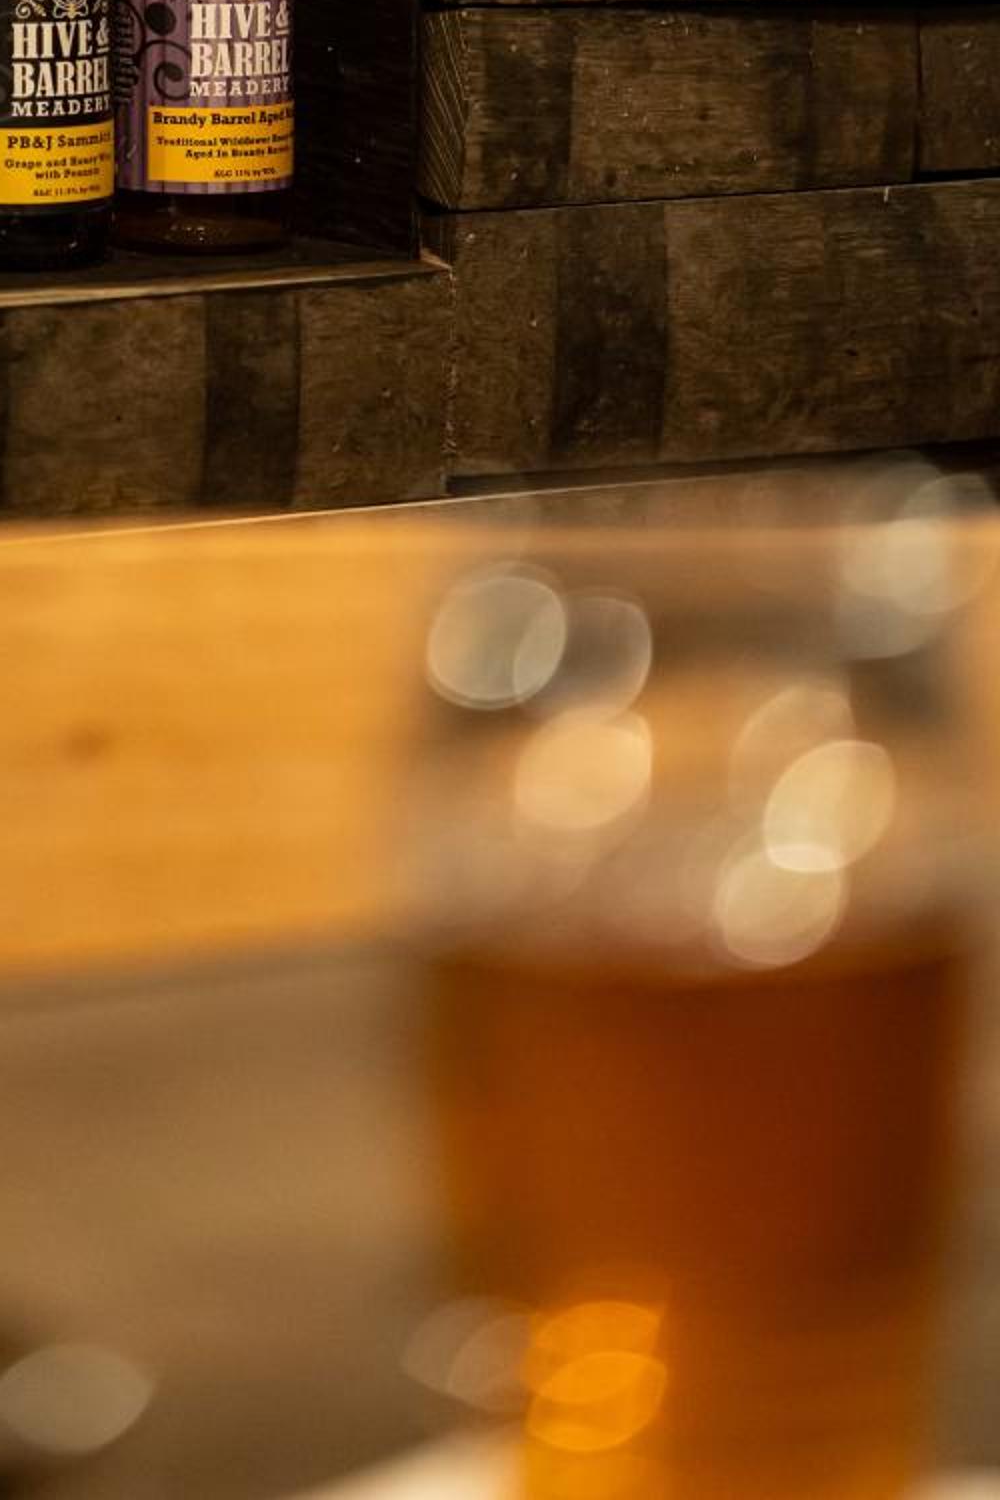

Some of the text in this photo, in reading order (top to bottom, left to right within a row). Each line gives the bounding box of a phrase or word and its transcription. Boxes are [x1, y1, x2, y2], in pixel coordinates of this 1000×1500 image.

[190, 0, 290, 39] HIVE &
[11, 17, 110, 59] HIVE &
[191, 38, 289, 77] BARREL
[11, 56, 110, 98] BARREL
[189, 76, 290, 97] MEADERY
[153, 112, 207, 129] Brandy
[211, 111, 256, 125] Barrel
[259, 110, 285, 126] Aged
[7, 135, 53, 151] PB&J
[157, 137, 217, 147] Traditional
[5, 158, 43, 170] Grape
[46, 157, 67, 168] and
[35, 169, 61, 180] with
